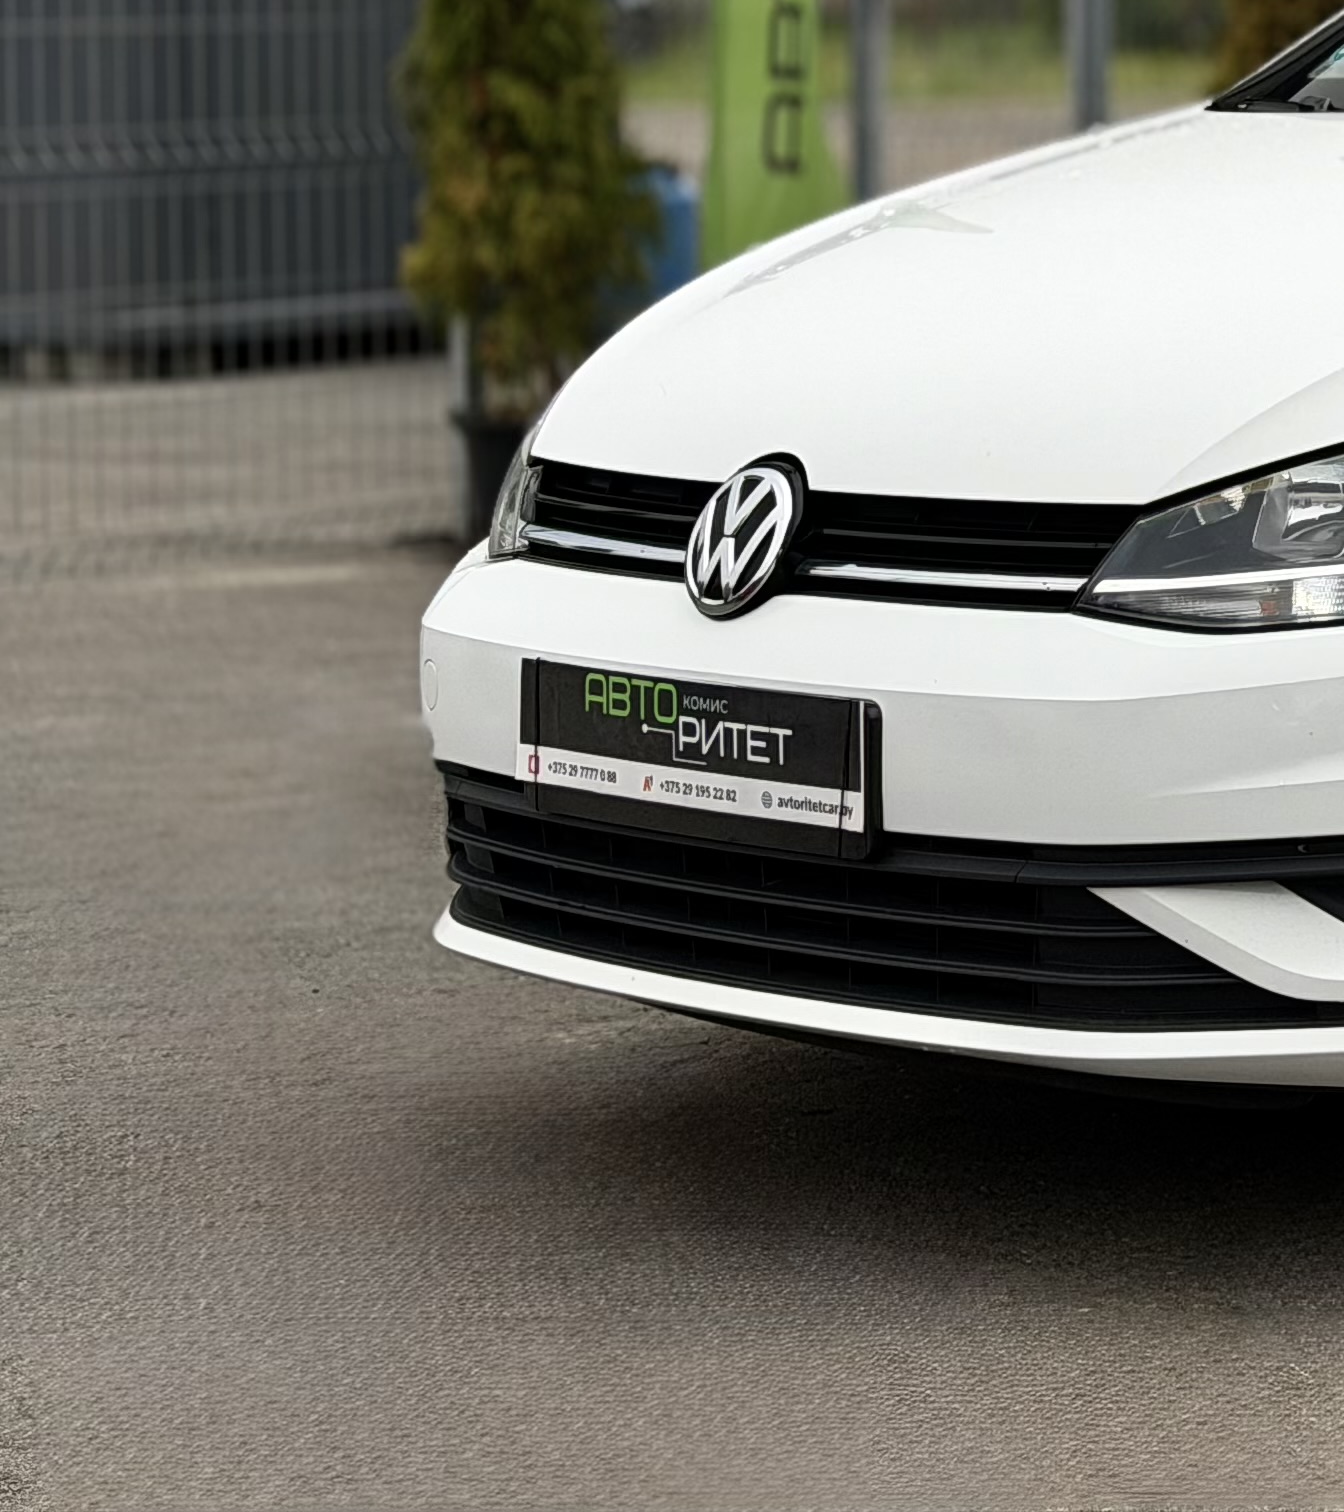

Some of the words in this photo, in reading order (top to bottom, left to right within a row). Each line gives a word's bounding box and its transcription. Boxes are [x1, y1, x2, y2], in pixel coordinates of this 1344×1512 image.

[585, 672, 677, 724] АВТО
[682, 694, 729, 715] КОМИС
[679, 715, 793, 766] РИТЕТ
[547, 761, 567, 776] +375
[568, 765, 578, 777] 29
[660, 780, 680, 795] +375
[682, 782, 693, 796] 29
